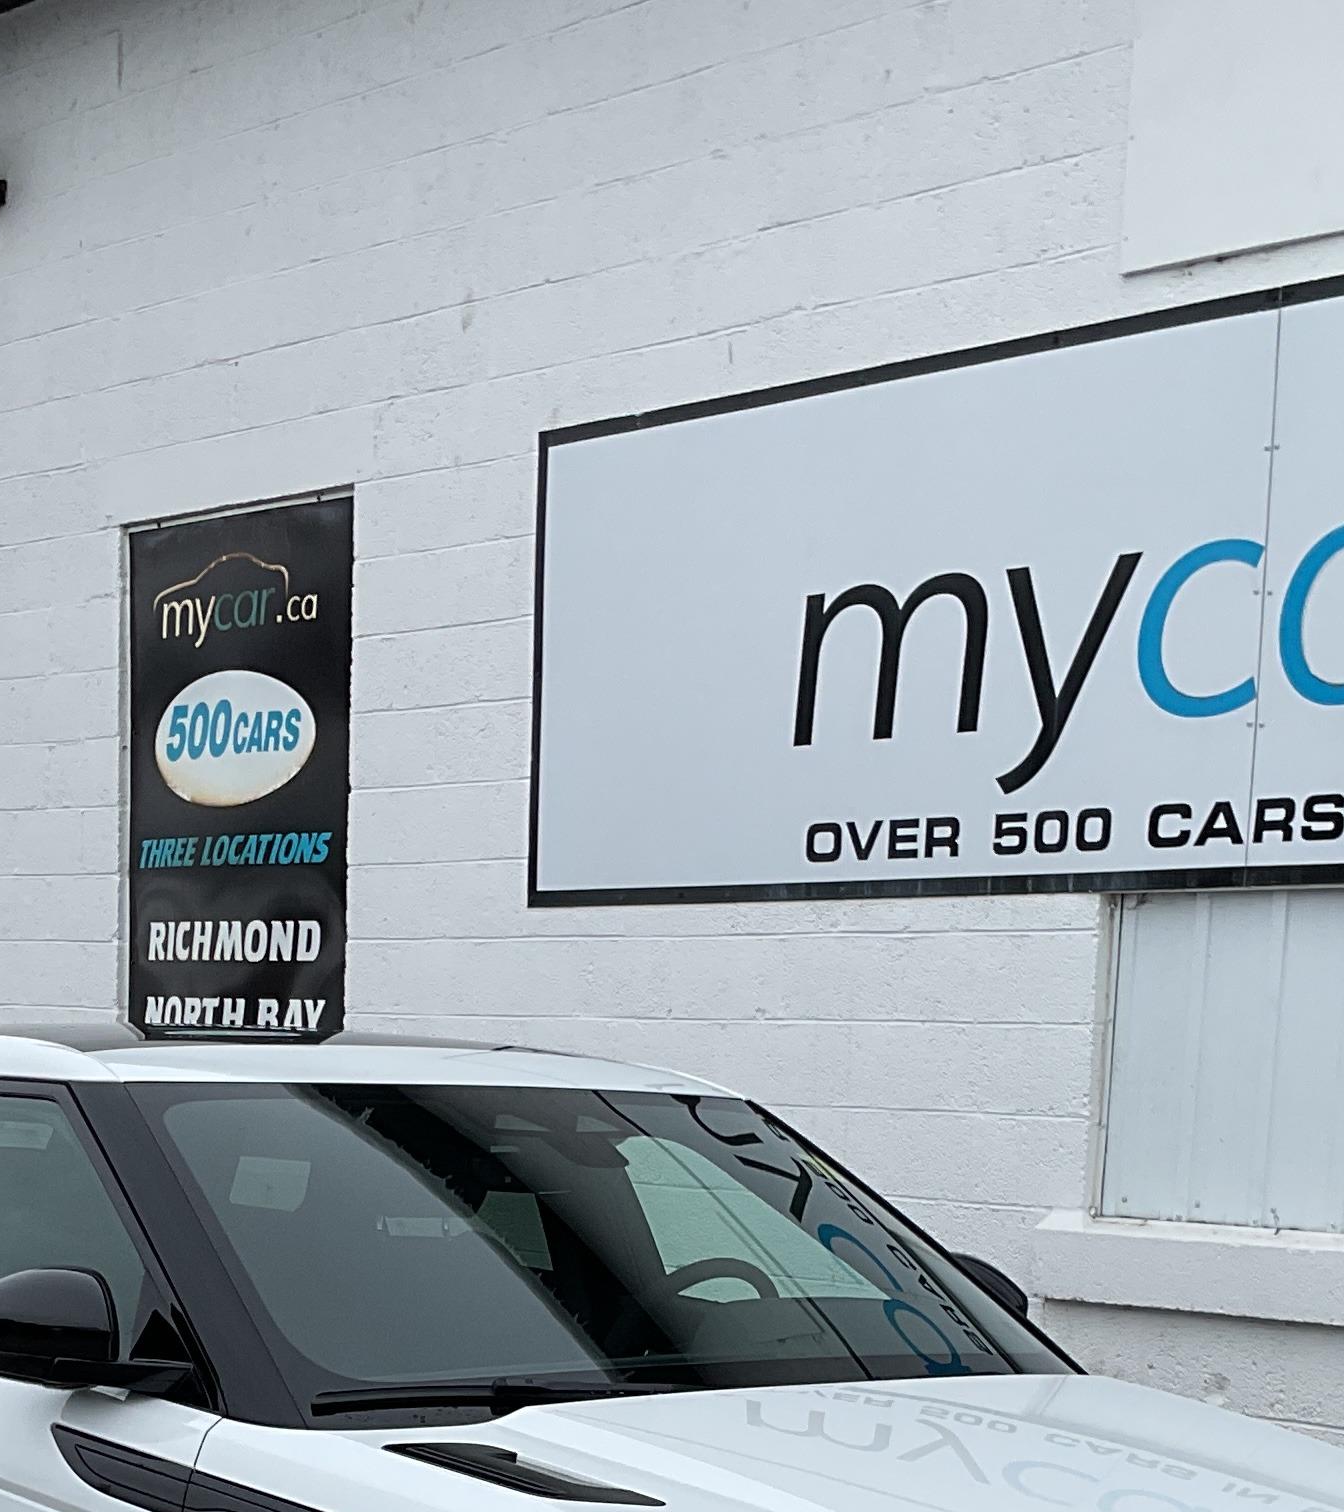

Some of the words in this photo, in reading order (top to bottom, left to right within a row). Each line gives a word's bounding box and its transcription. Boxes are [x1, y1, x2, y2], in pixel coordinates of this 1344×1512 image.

[161, 587, 319, 648] mycar.ca
[139, 837, 199, 869] THREE
[199, 831, 333, 867] LOCATIONS
[805, 816, 961, 863] OVER
[992, 807, 1112, 855] 500
[148, 919, 322, 962] RICHMOND
[144, 995, 246, 1026] NORTH
[256, 998, 327, 1032] BAY
